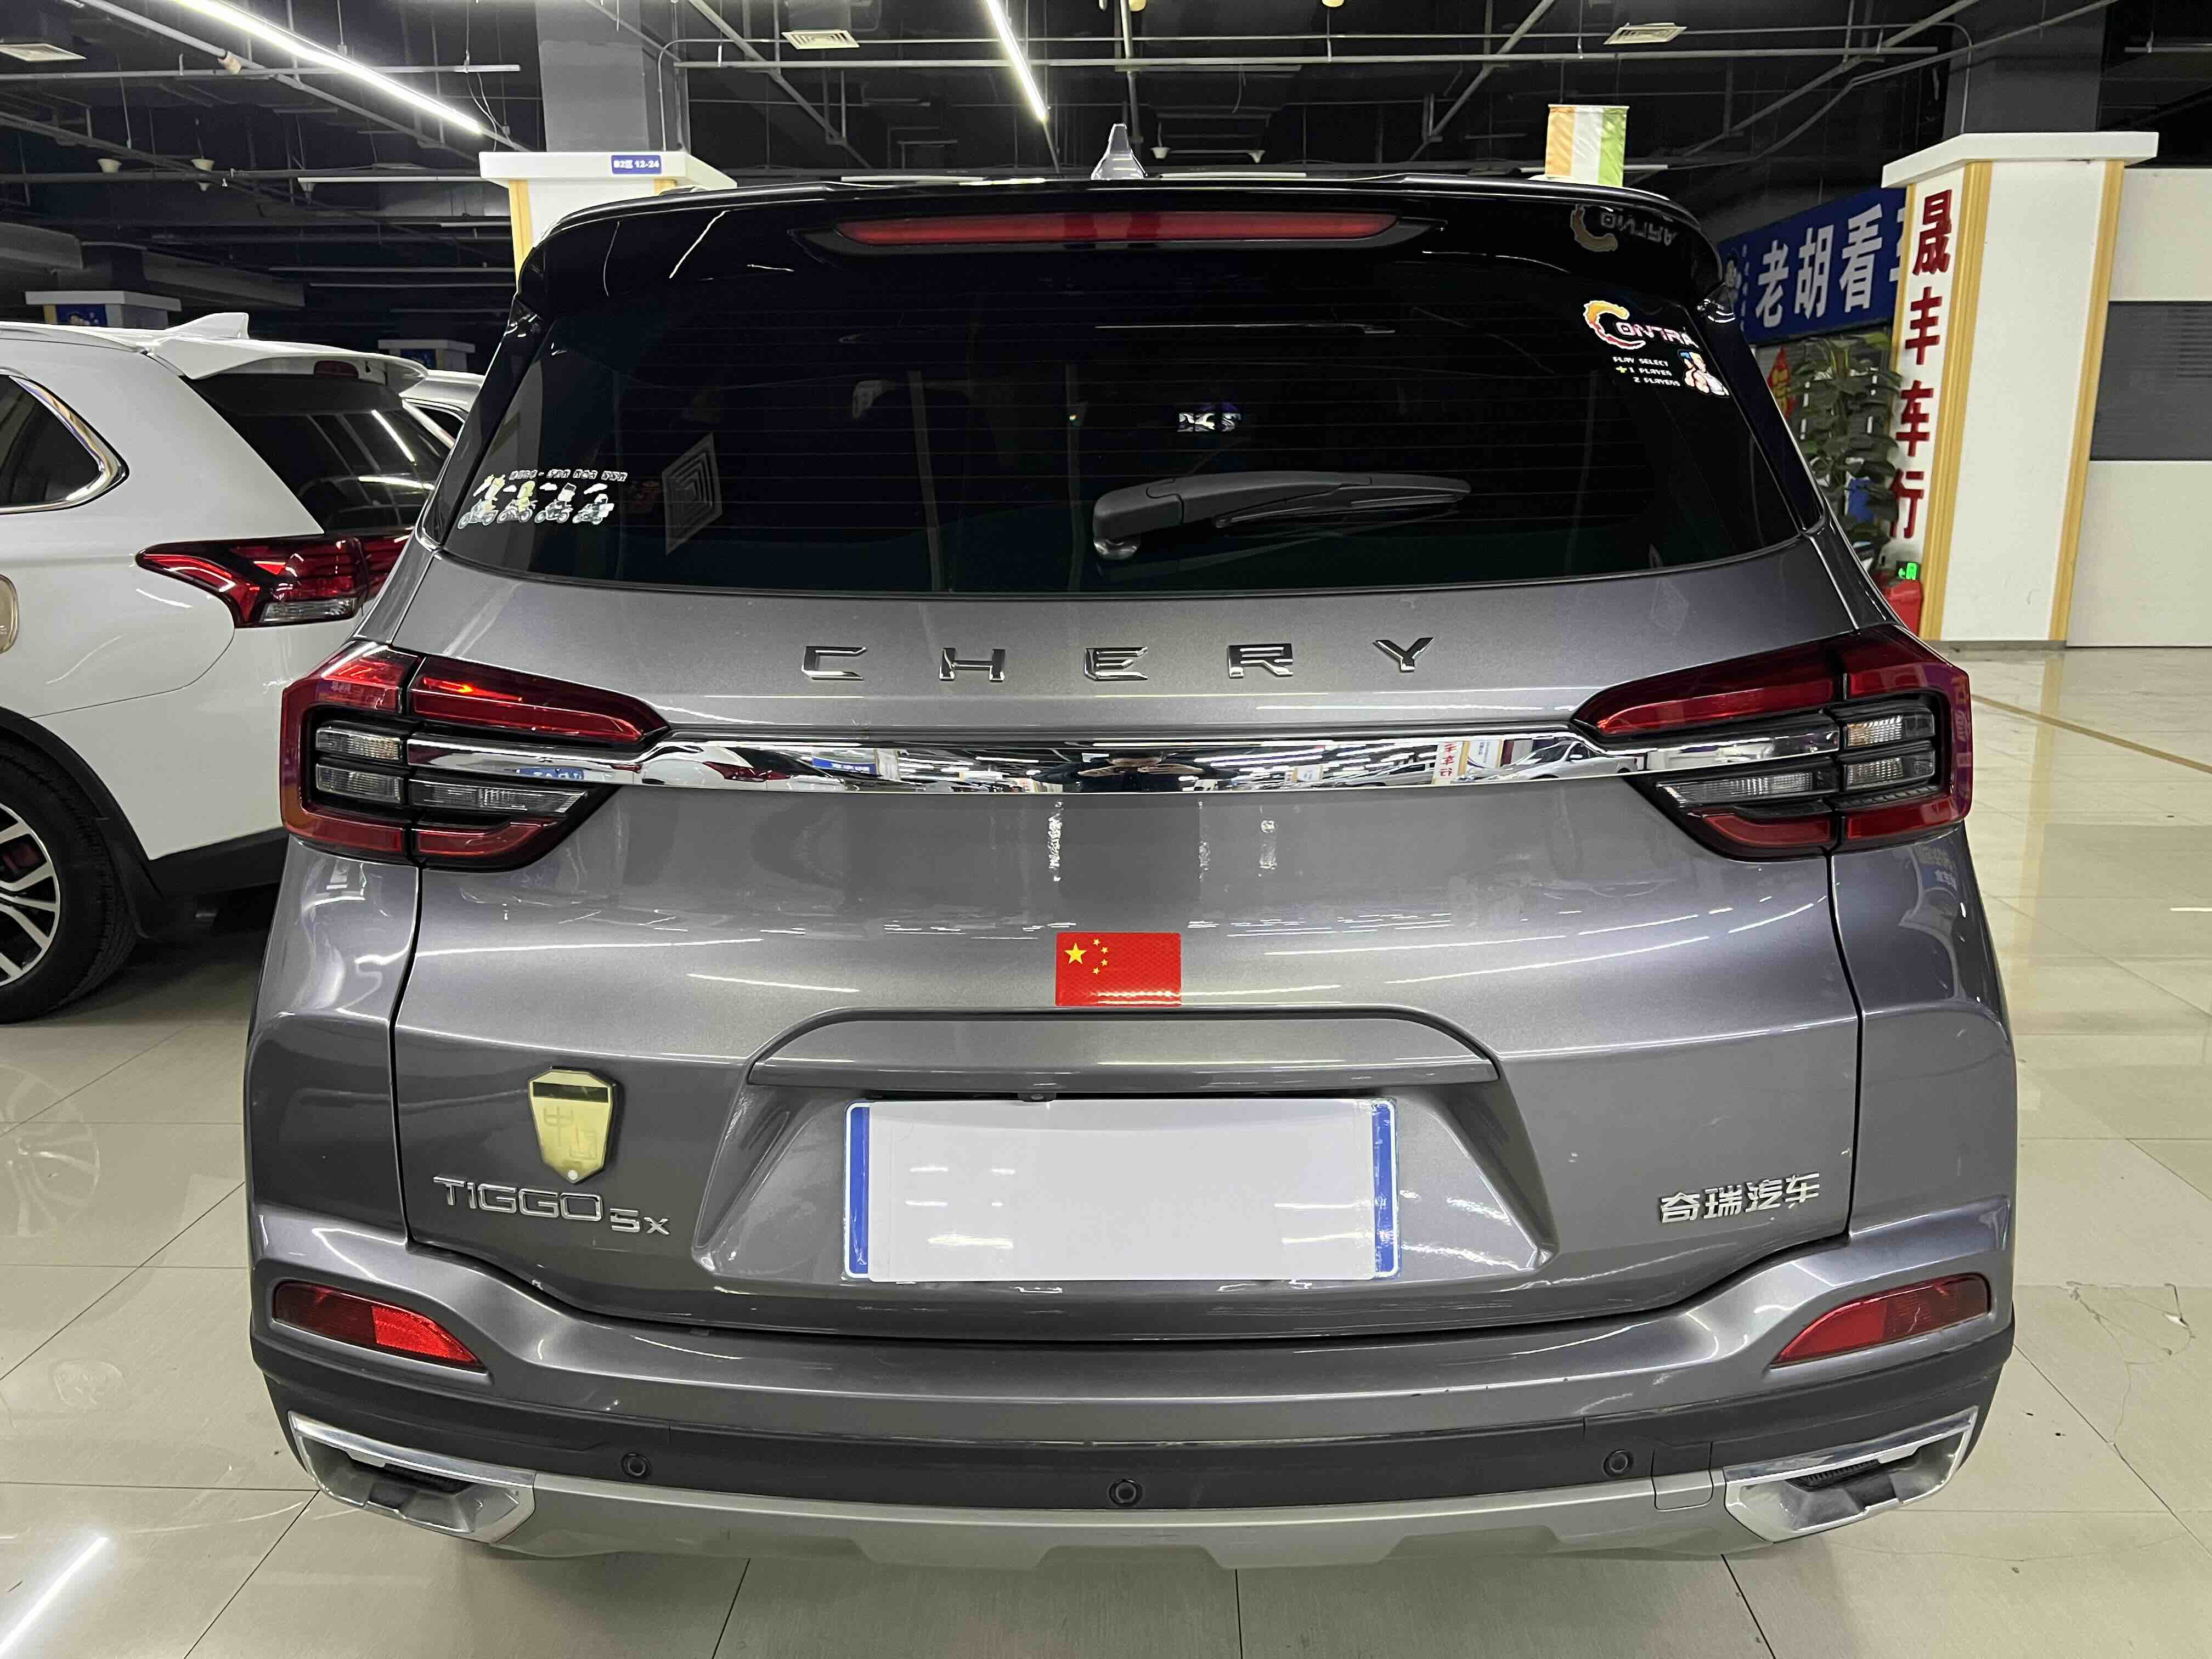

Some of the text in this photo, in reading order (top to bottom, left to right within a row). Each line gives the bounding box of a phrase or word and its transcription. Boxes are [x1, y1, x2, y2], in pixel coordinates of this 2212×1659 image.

[1890, 189, 1953, 539] 晟丰车行
[802, 636, 1435, 682] CHERY
[433, 1176, 603, 1222] TIGGO
[1659, 1172, 1820, 1224] 奇瑞汽车
